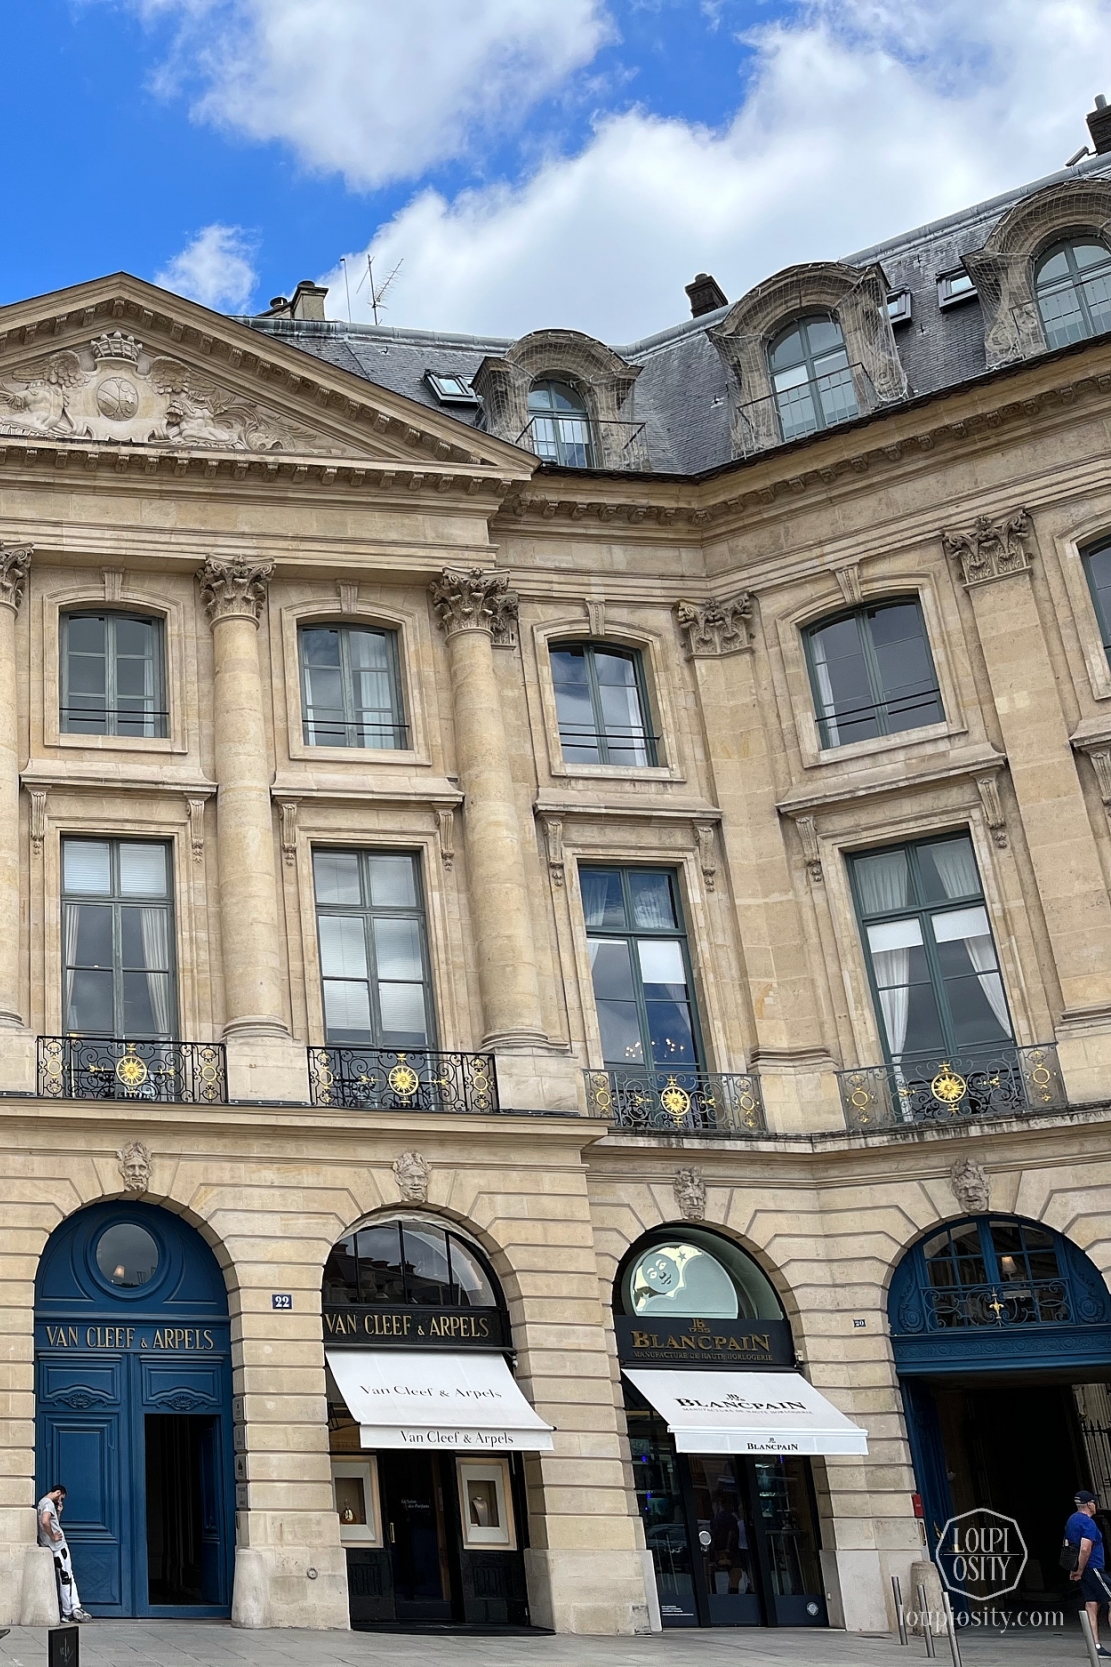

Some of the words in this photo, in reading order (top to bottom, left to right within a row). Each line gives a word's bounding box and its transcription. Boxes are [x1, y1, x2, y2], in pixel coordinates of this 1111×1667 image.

[275, 1296, 290, 1308] 22
[325, 1313, 358, 1335] VAN
[364, 1315, 412, 1336] CLEEF
[417, 1325, 425, 1336] &
[429, 1316, 490, 1338] ARPELS
[45, 1326, 79, 1347] VAN
[86, 1327, 136, 1348] CLEEF
[141, 1337, 148, 1348] &
[152, 1328, 215, 1350] ARPELS
[630, 1330, 770, 1352] BLANCPAIN
[359, 1385, 390, 1396] Van
[393, 1385, 434, 1397] Cleef
[439, 1389, 450, 1398] &
[454, 1387, 502, 1399] Arpels
[675, 1398, 807, 1410] BLANCPAIN
[400, 1430, 424, 1443] Van
[427, 1430, 460, 1444] Cleef
[463, 1434, 473, 1444] &
[475, 1431, 514, 1448] Arpels
[747, 1442, 799, 1451] BLANCPAIN
